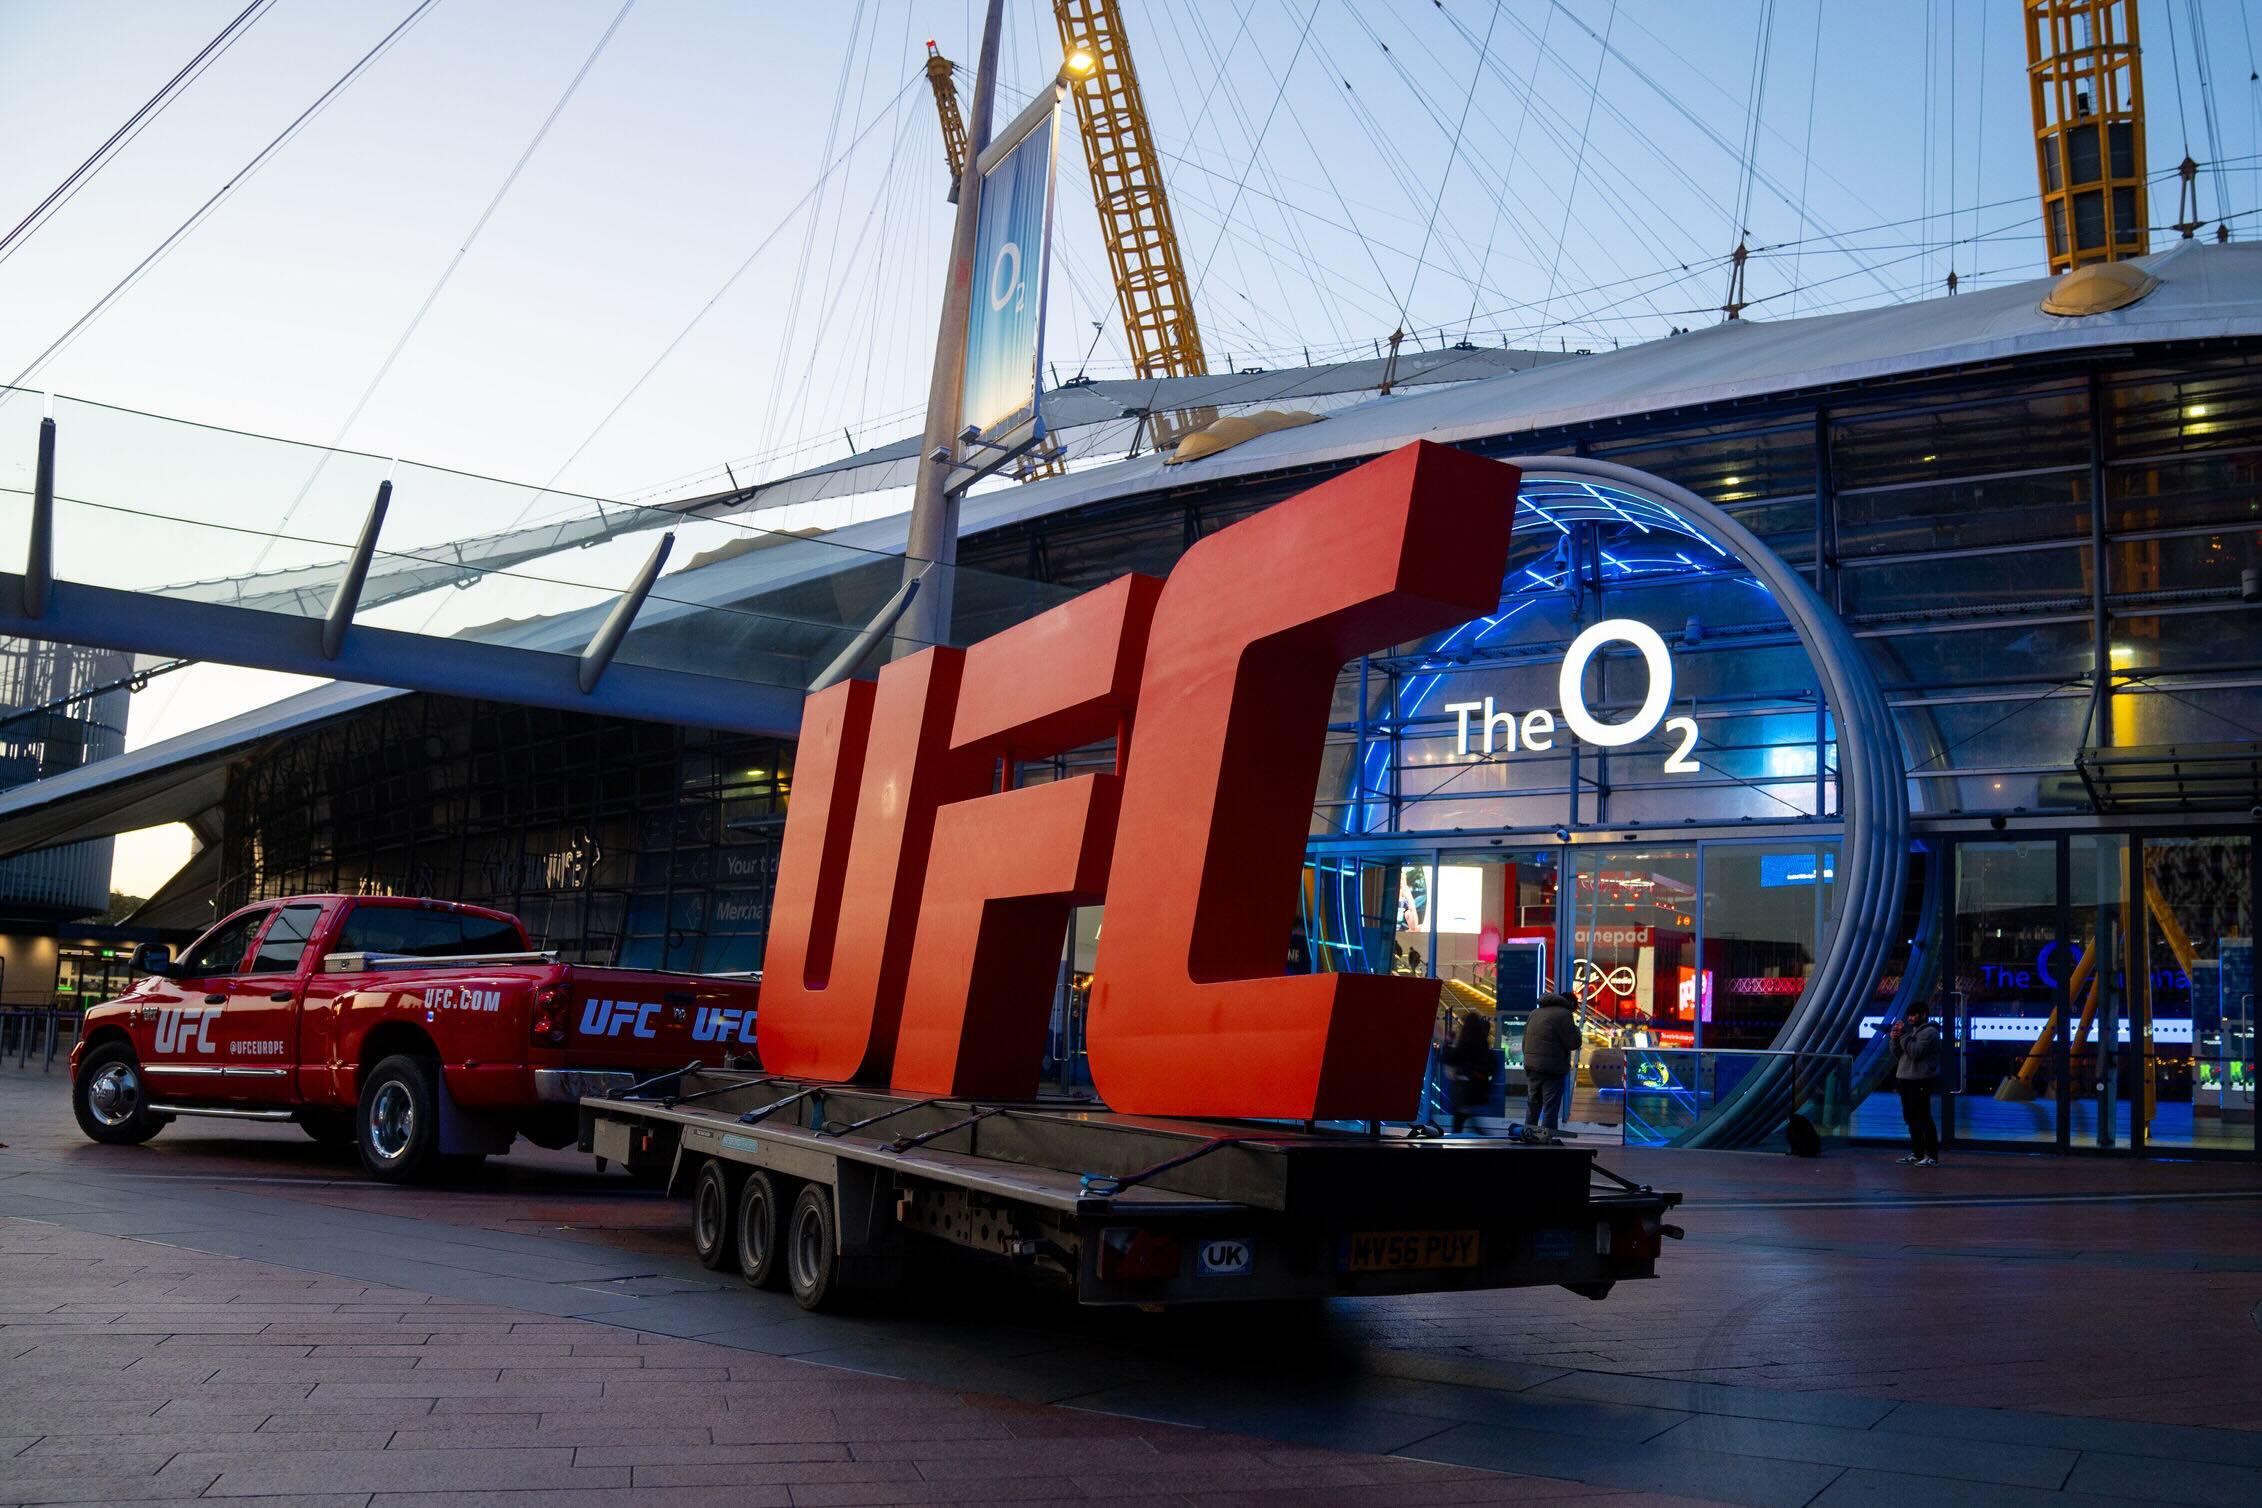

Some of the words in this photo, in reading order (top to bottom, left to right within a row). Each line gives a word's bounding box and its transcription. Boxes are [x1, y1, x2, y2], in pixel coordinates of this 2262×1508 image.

[991, 242, 1026, 312] O2
[1444, 697, 1555, 755] The
[1559, 618, 1700, 773] O2
[757, 440, 1521, 1120] UFC
[728, 856, 756, 874] Your
[716, 902, 771, 920] Mercha
[1574, 927, 1648, 945] amepad
[1979, 965, 2031, 991] The
[424, 988, 501, 1012] UFC.COM
[155, 1008, 223, 1053] UFC
[579, 999, 663, 1039] UFC
[691, 1007, 758, 1044] UFC
[230, 1040, 285, 1055] @UFCEUROPE
[1208, 1246, 1243, 1265] UK
[1425, 1233, 1473, 1263] PUY
